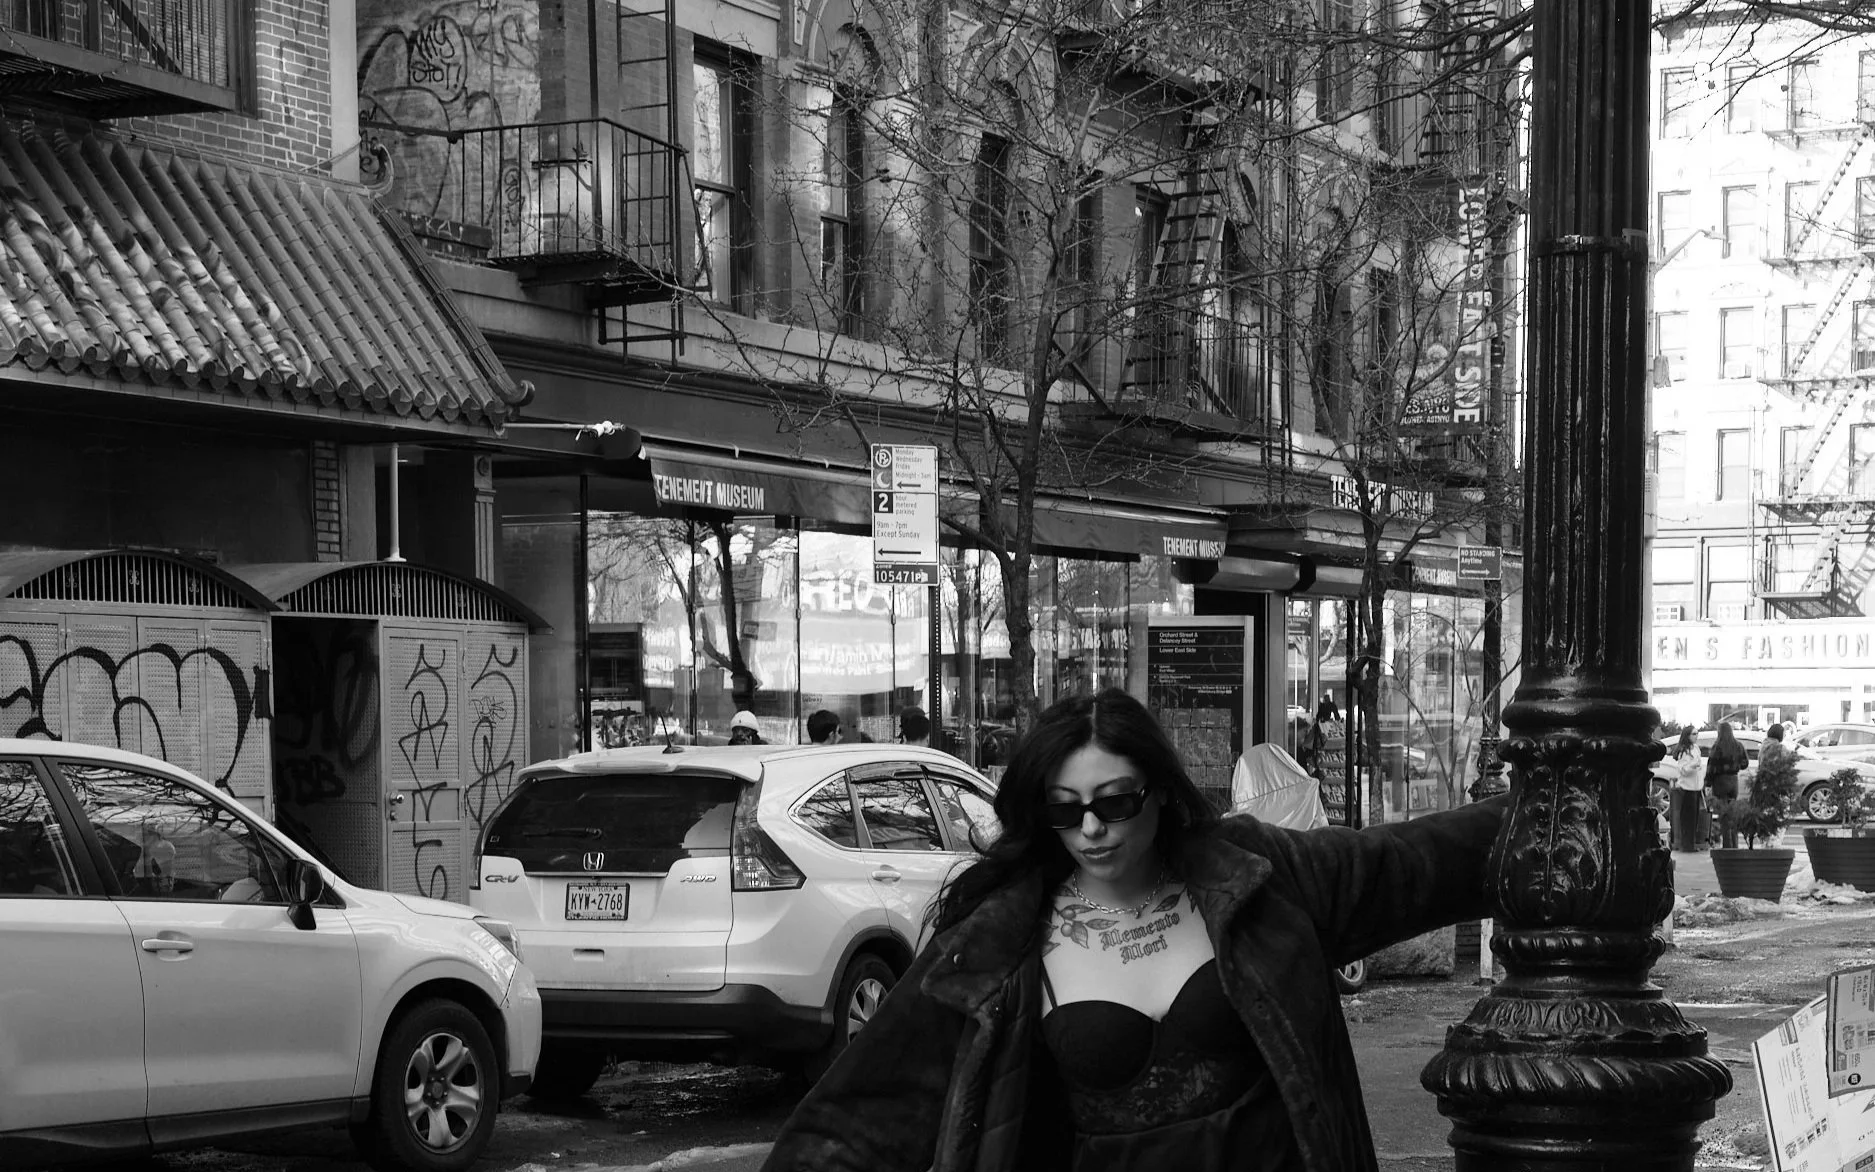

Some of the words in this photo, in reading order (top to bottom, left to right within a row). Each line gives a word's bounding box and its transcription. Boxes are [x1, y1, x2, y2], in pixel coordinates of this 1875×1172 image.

[1454, 367, 1482, 424] SIDE
[654, 474, 713, 504] TENEMENT
[717, 482, 764, 510] MUSEUM
[878, 493, 889, 512] 2
[876, 531, 896, 539] Except
[899, 531, 920, 539] Sunday
[895, 522, 908, 530] 7pm
[1163, 536, 1198, 556] TENEMENT
[876, 570, 914, 583] 105471
[1742, 633, 1870, 660] FASHION
[485, 875, 519, 883] CR-V
[680, 874, 717, 883] AWD
[598, 893, 622, 911] 2768
[1099, 912, 1180, 951] Memento
[1120, 934, 1168, 965] Mori
